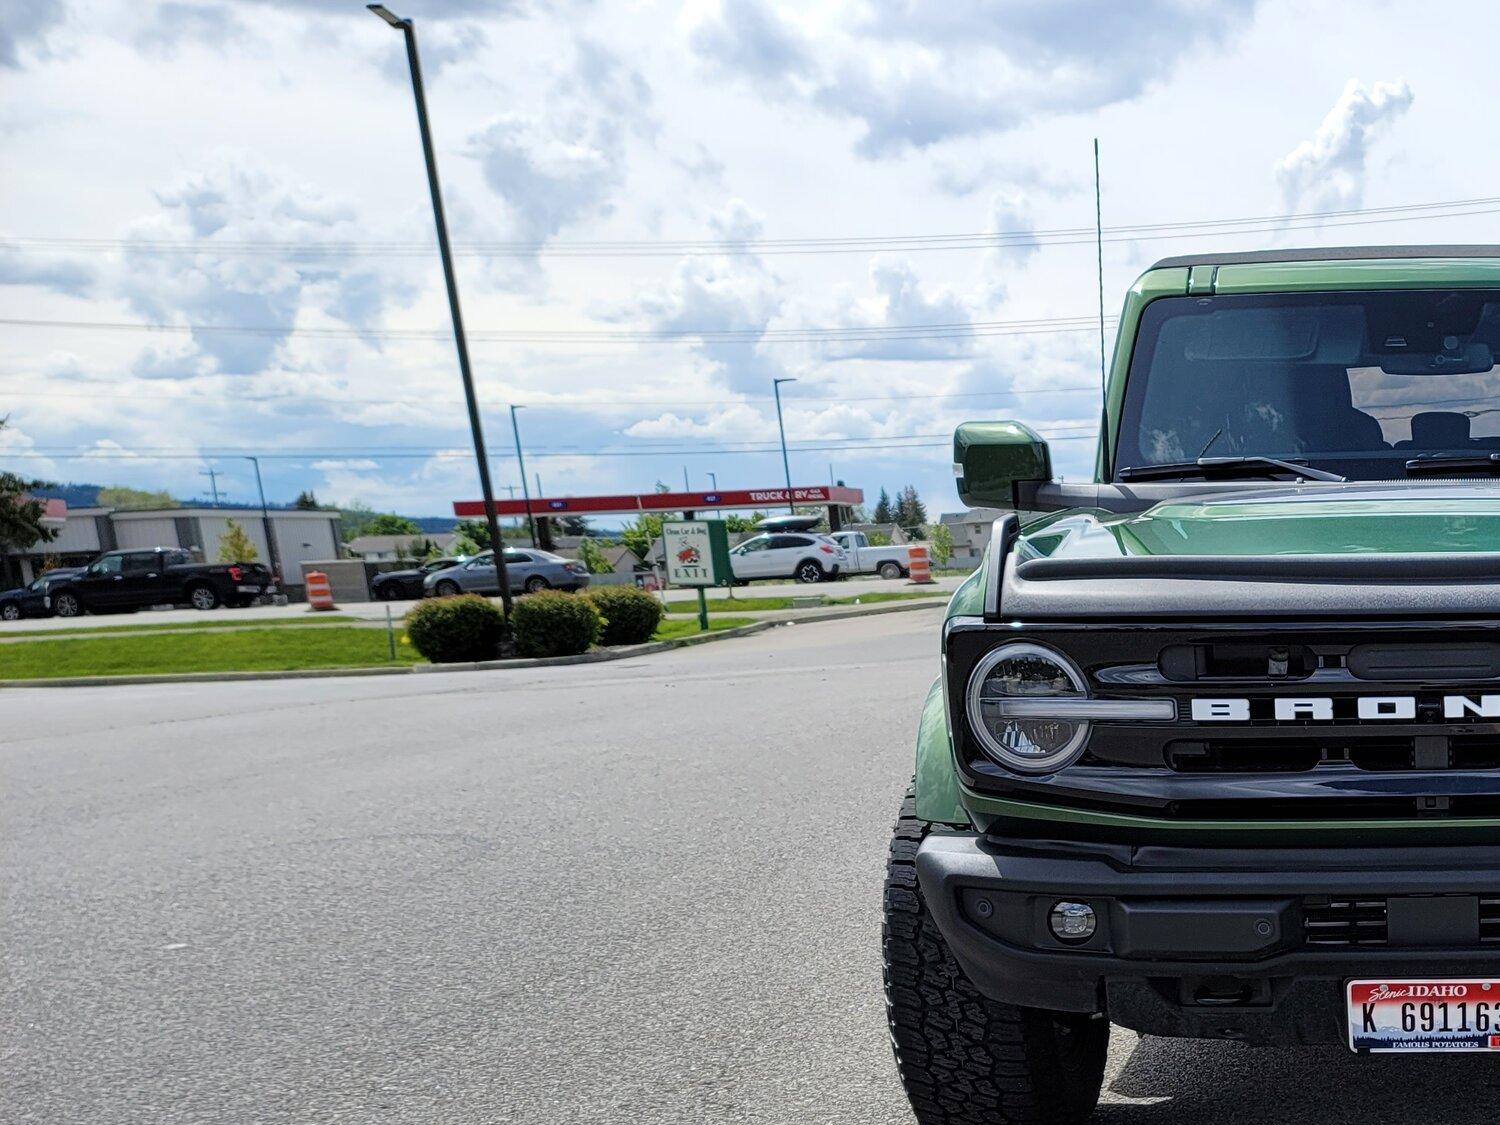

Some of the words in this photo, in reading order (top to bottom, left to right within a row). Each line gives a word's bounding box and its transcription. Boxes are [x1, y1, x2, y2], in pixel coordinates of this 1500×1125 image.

[750, 489, 784, 500] TRUCK
[795, 489, 807, 499] RV
[674, 569, 708, 578] EXIT
[1368, 987, 1410, 1002] Scenic
[1407, 985, 1467, 997] IDAHO
[1362, 1002, 1377, 1033] K
